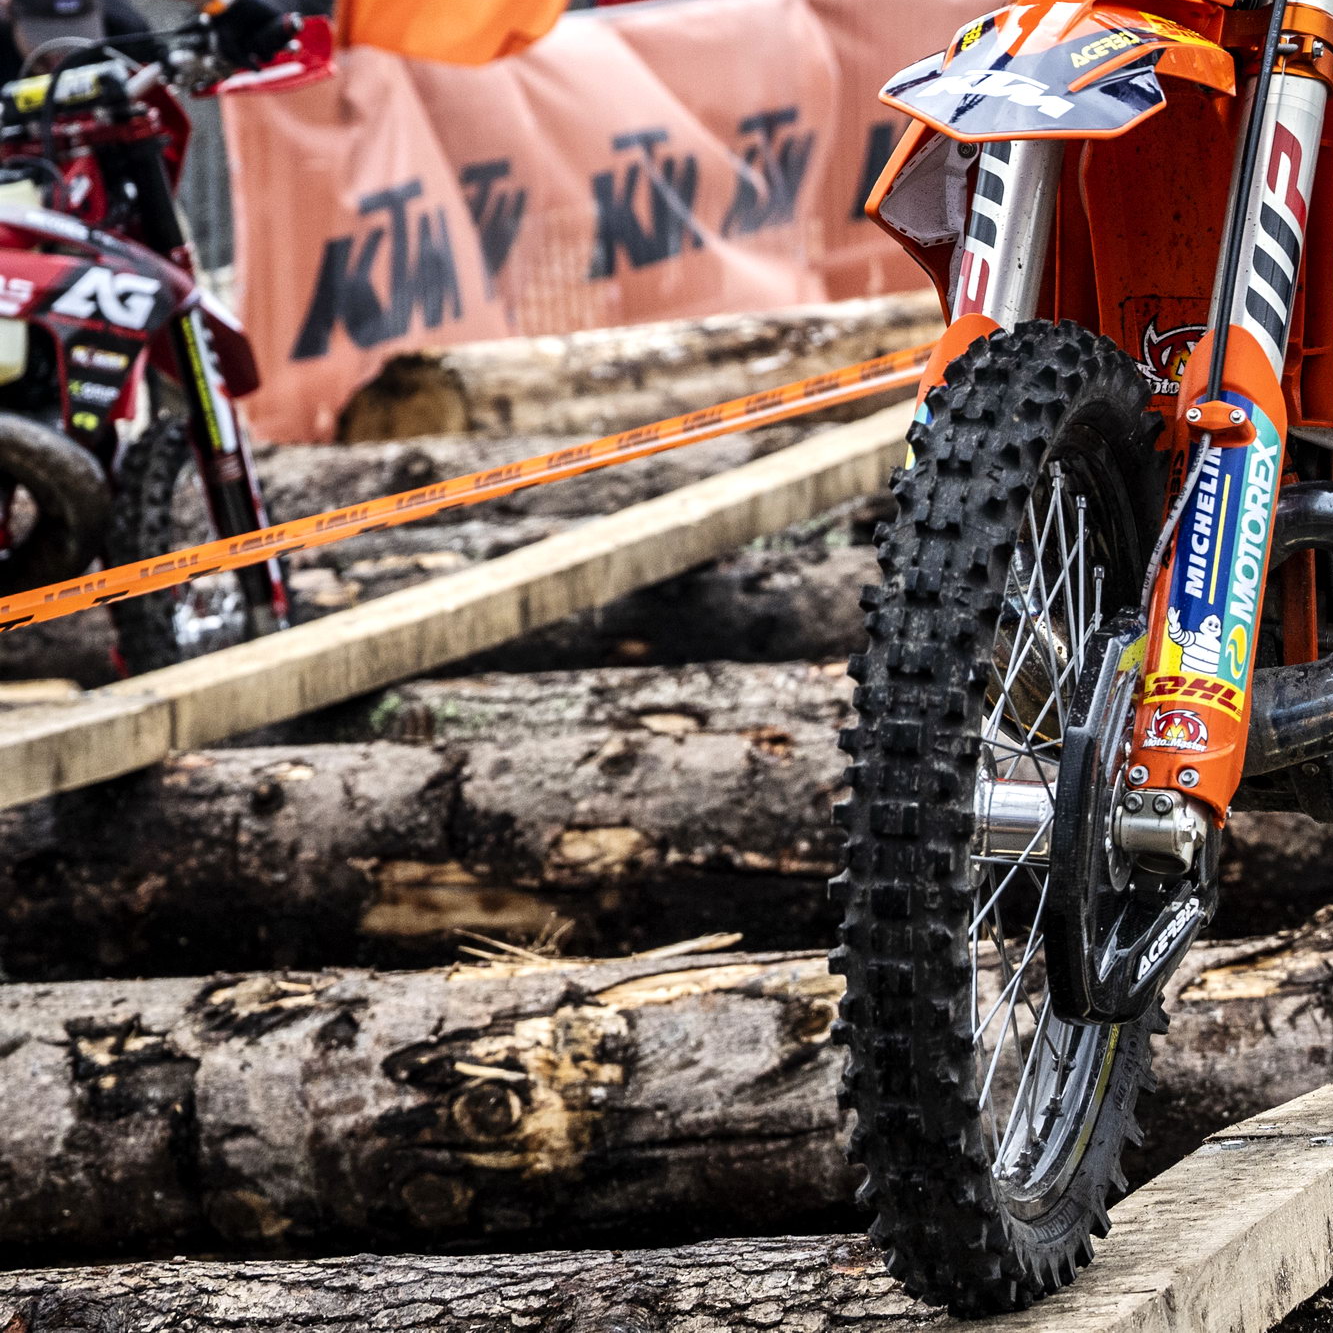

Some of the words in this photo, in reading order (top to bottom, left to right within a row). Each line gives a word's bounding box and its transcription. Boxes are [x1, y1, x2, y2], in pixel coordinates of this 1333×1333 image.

[916, 70, 1075, 119] KTM
[292, 181, 462, 360] KTM
[1185, 447, 1223, 599] MICHELIN
[1231, 443, 1277, 624] MOTOREX
[1149, 676, 1237, 712] DHL
[1138, 897, 1199, 980] ACERBIS
